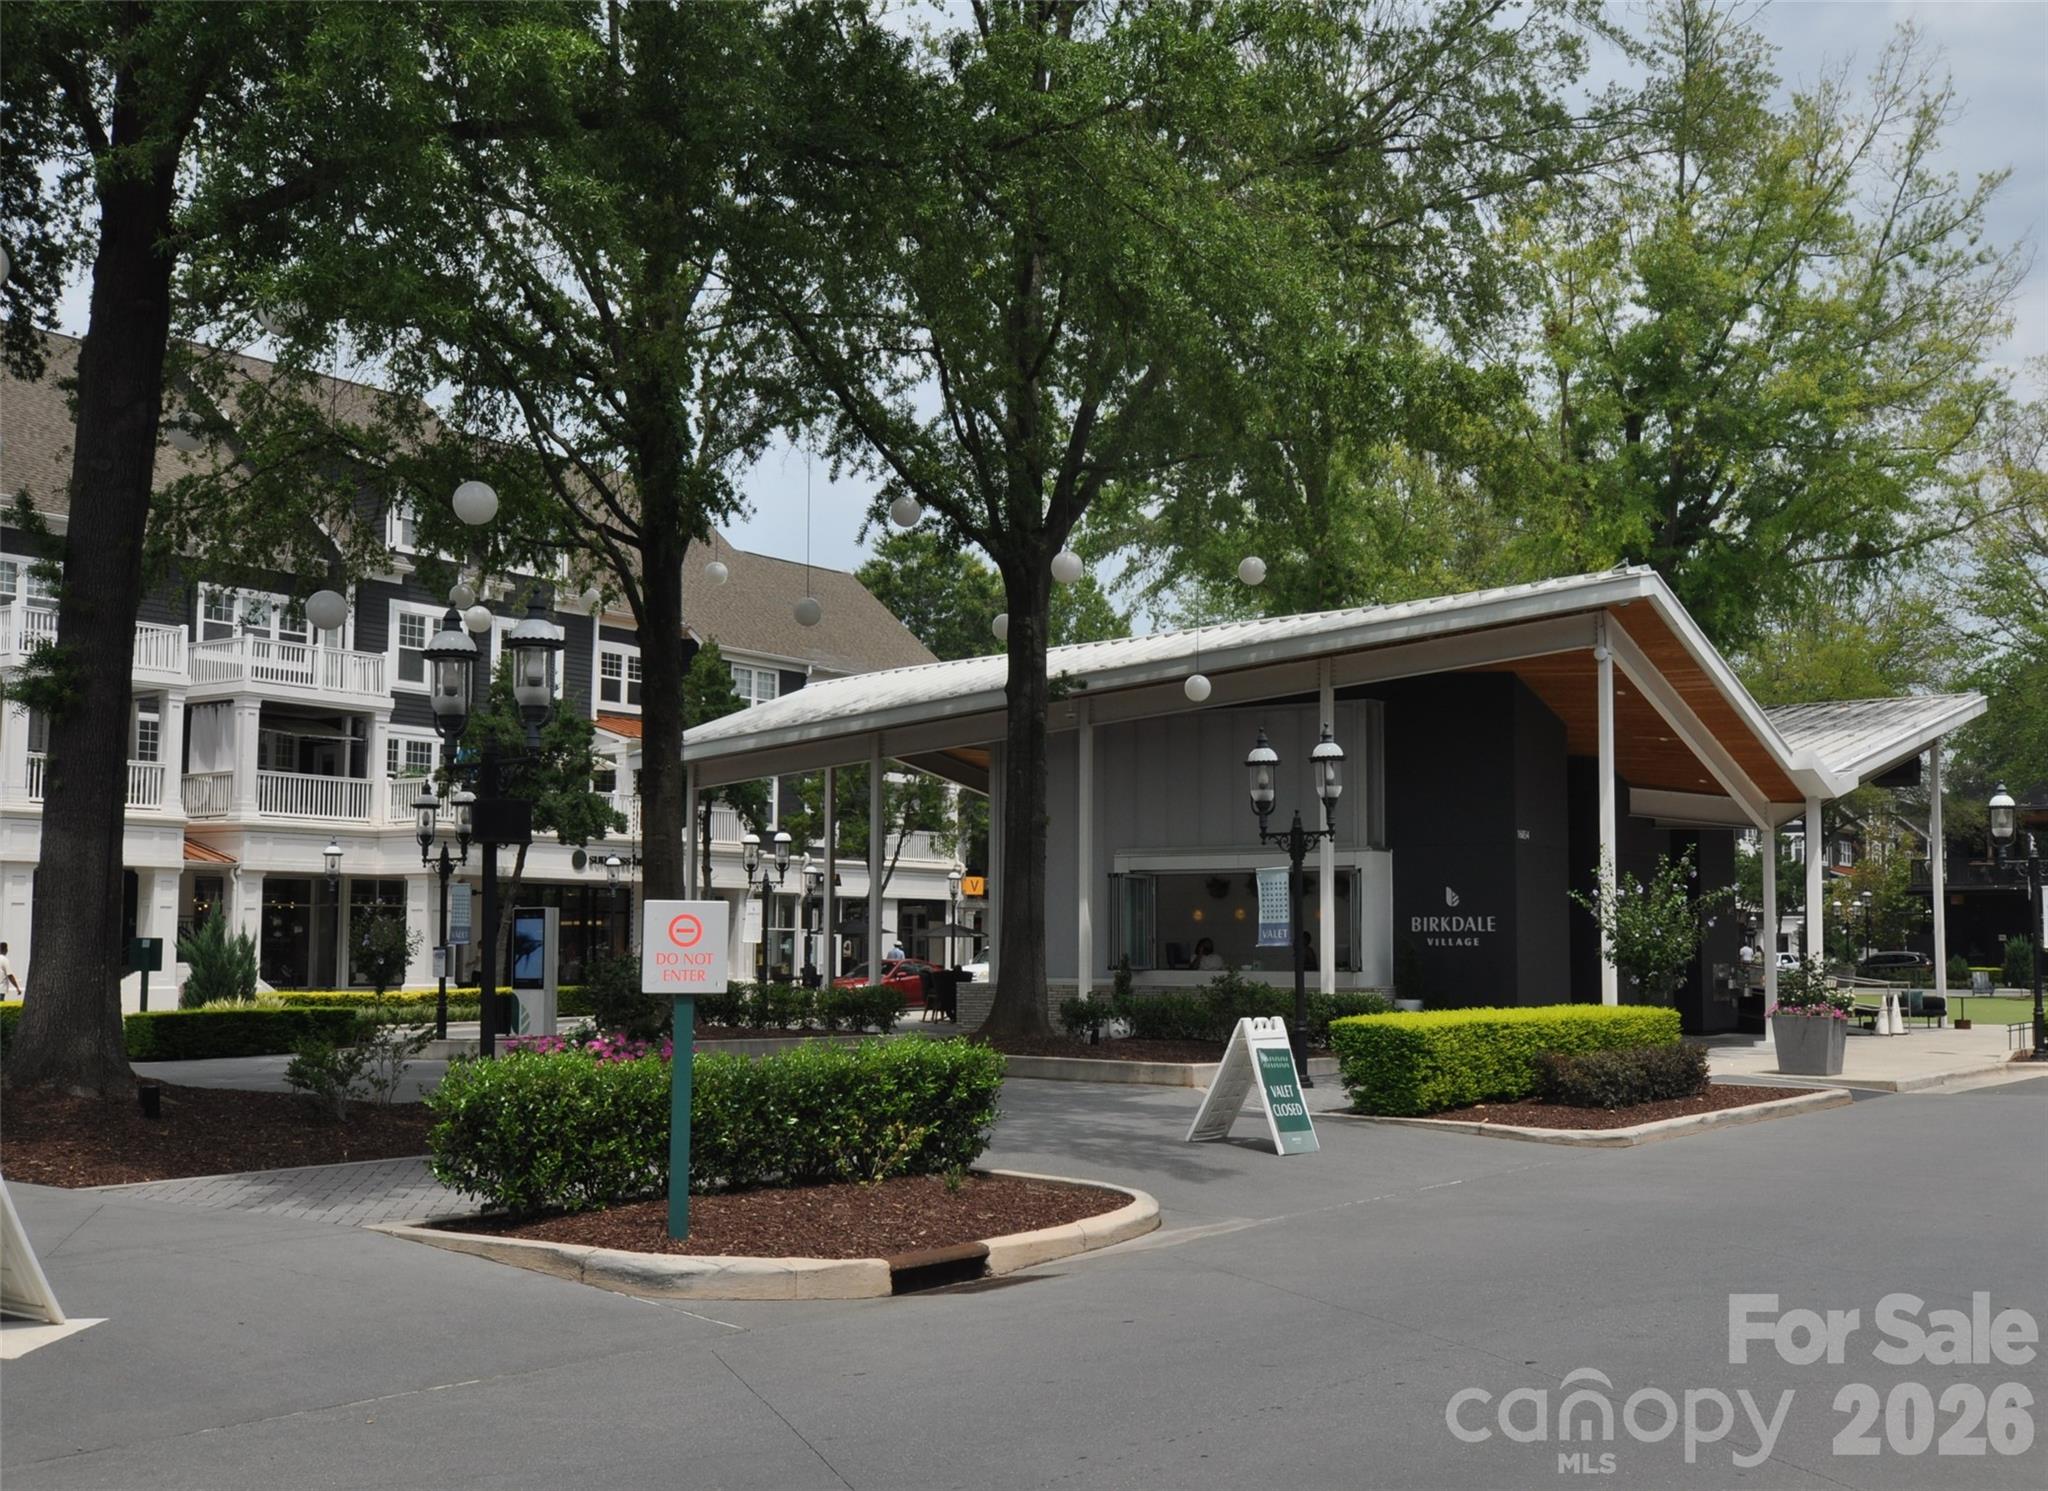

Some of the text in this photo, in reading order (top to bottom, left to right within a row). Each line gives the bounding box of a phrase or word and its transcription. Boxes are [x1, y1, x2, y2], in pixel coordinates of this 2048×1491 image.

[970, 879, 979, 892] V
[1411, 916, 1496, 932] BIRKDALE
[1262, 928, 1288, 939] VALET
[1427, 938, 1480, 946] VILLAGE
[656, 952, 714, 966] DO NOT
[663, 969, 706, 982] ENTER
[1270, 1085, 1294, 1098] VALET
[1272, 1103, 1303, 1117] CLOSED
